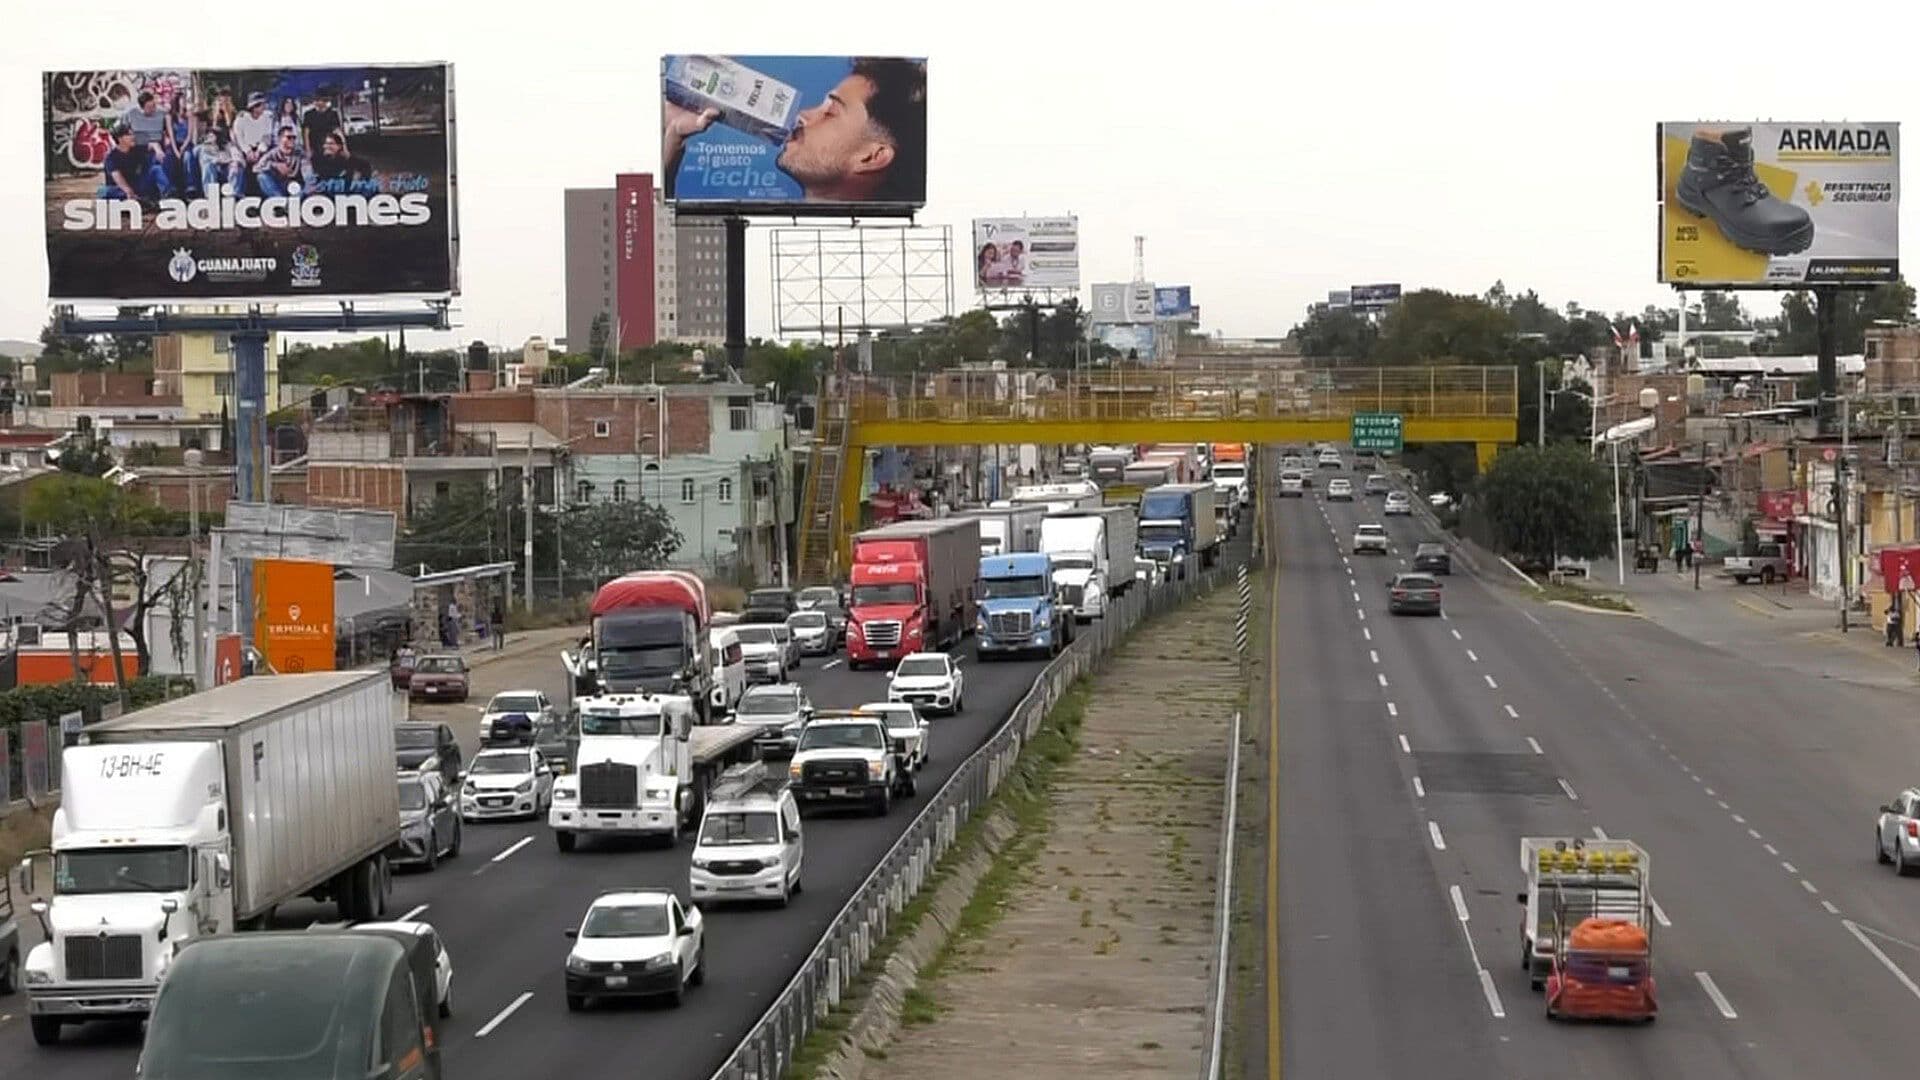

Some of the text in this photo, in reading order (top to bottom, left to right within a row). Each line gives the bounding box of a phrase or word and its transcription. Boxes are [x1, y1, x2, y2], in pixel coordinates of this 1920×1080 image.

[1778, 129, 1892, 151] ARMADA
[711, 155, 752, 169] gusto
[702, 167, 777, 187] leche
[1823, 183, 1892, 192] RESISTENCIA
[1832, 192, 1892, 202] SEGURIDAD
[63, 180, 432, 231] sin adicciones
[198, 257, 277, 271] GUANAJUATO
[1355, 417, 1392, 427] RETORNO
[1355, 427, 1400, 438] EN PUERTO
[1358, 438, 1395, 447] INTERIOR
[100, 752, 164, 779] 13-BH-4E
